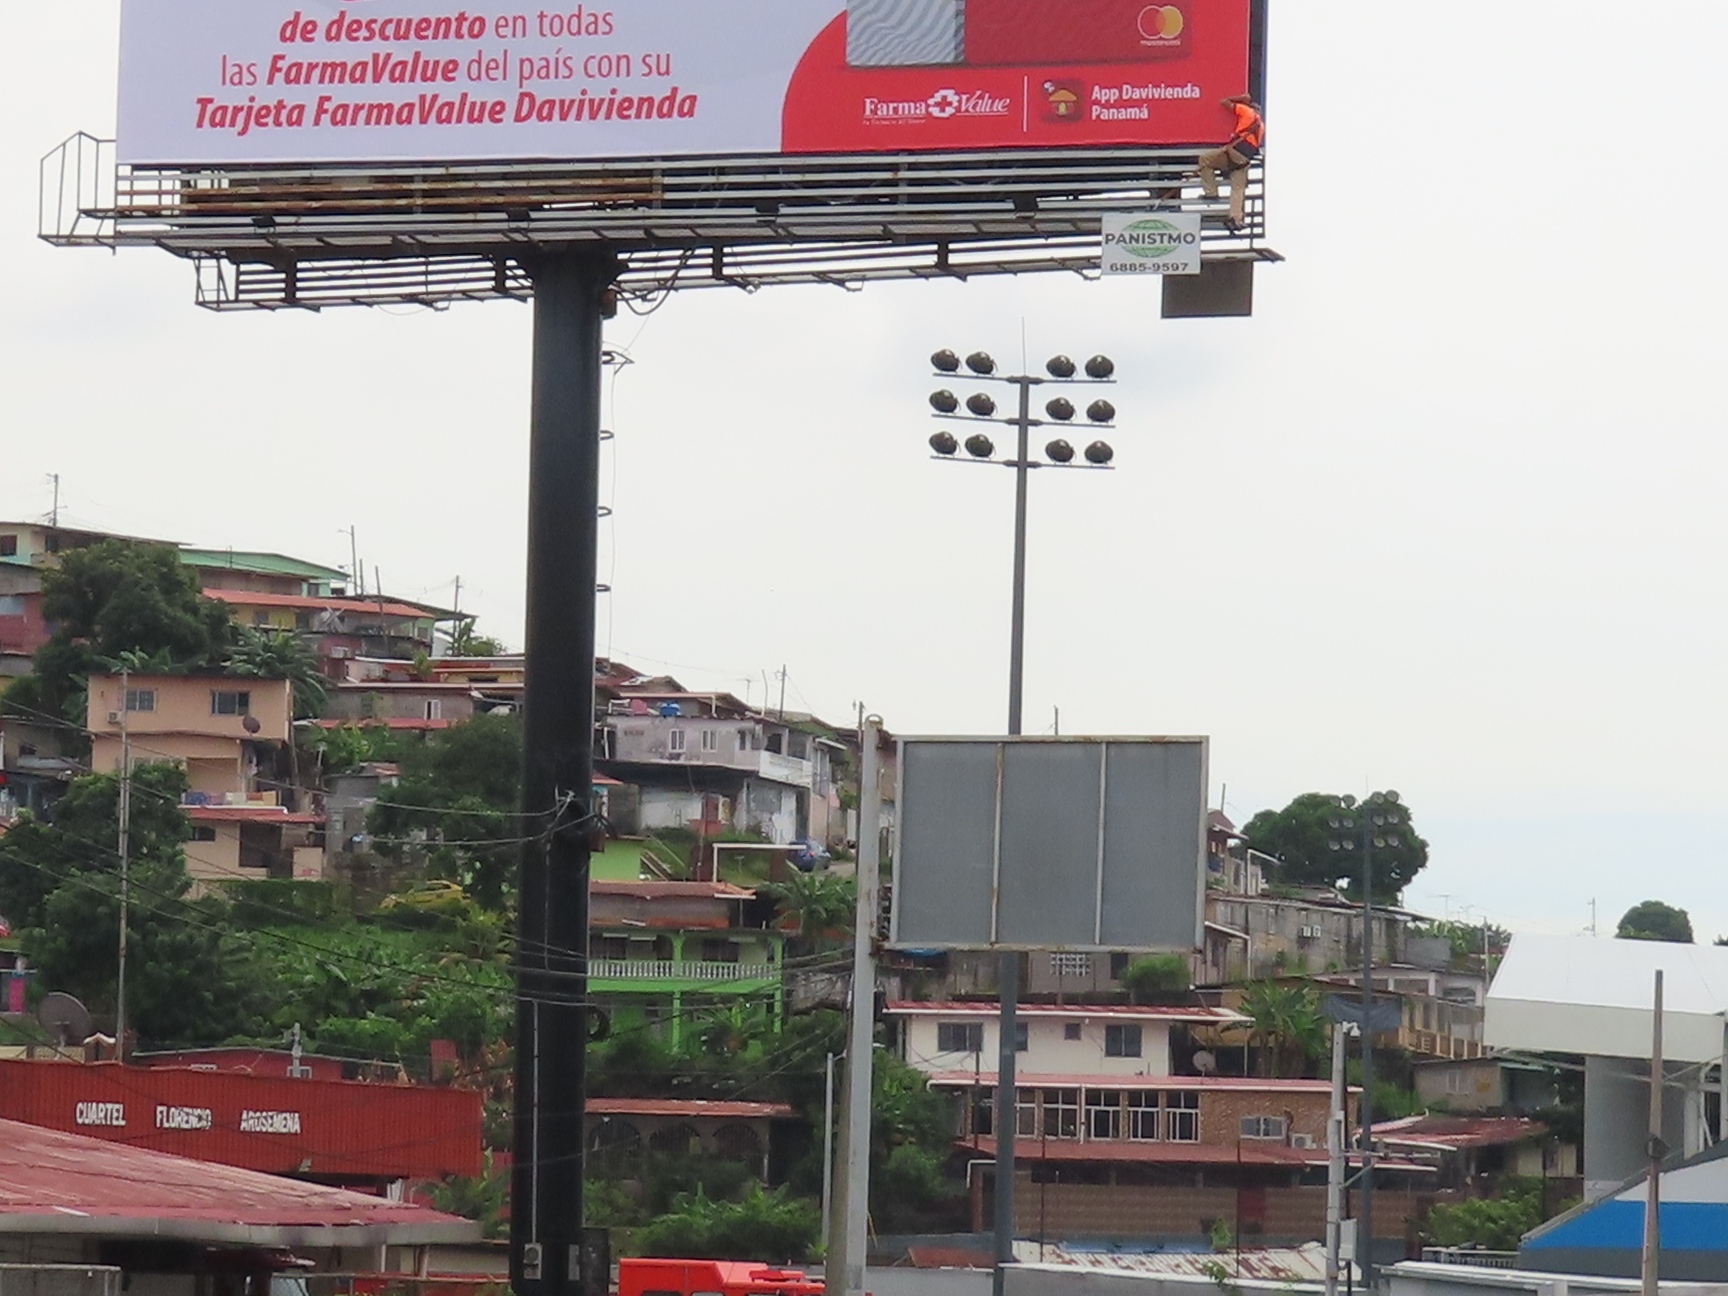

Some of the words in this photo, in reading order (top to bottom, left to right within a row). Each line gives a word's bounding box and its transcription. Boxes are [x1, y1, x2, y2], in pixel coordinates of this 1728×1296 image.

[278, 11, 317, 43] de
[324, 8, 486, 43] descuento
[494, 14, 527, 39] en
[537, 4, 614, 39] todas
[220, 55, 257, 86] las
[266, 51, 459, 86] FarmaValue
[466, 49, 509, 82] del
[518, 47, 574, 88] país
[582, 53, 631, 80] con
[640, 51, 672, 78] su
[864, 97, 926, 117] Farma
[960, 90, 1010, 114] Value
[1091, 86, 1118, 104] App
[1121, 82, 1201, 101] Davivienda
[194, 96, 305, 135] Tarjeta
[313, 92, 506, 127] FarmaValue
[514, 87, 697, 124] Davivienda
[1091, 103, 1149, 121] Panamá
[1104, 232, 1196, 245] PANISTMO
[1109, 262, 1189, 272] 6885-9597
[75, 1102, 126, 1127] CUARTEL
[155, 1105, 212, 1130] FLORENCIO
[240, 1109, 301, 1135] AROSEMENA
